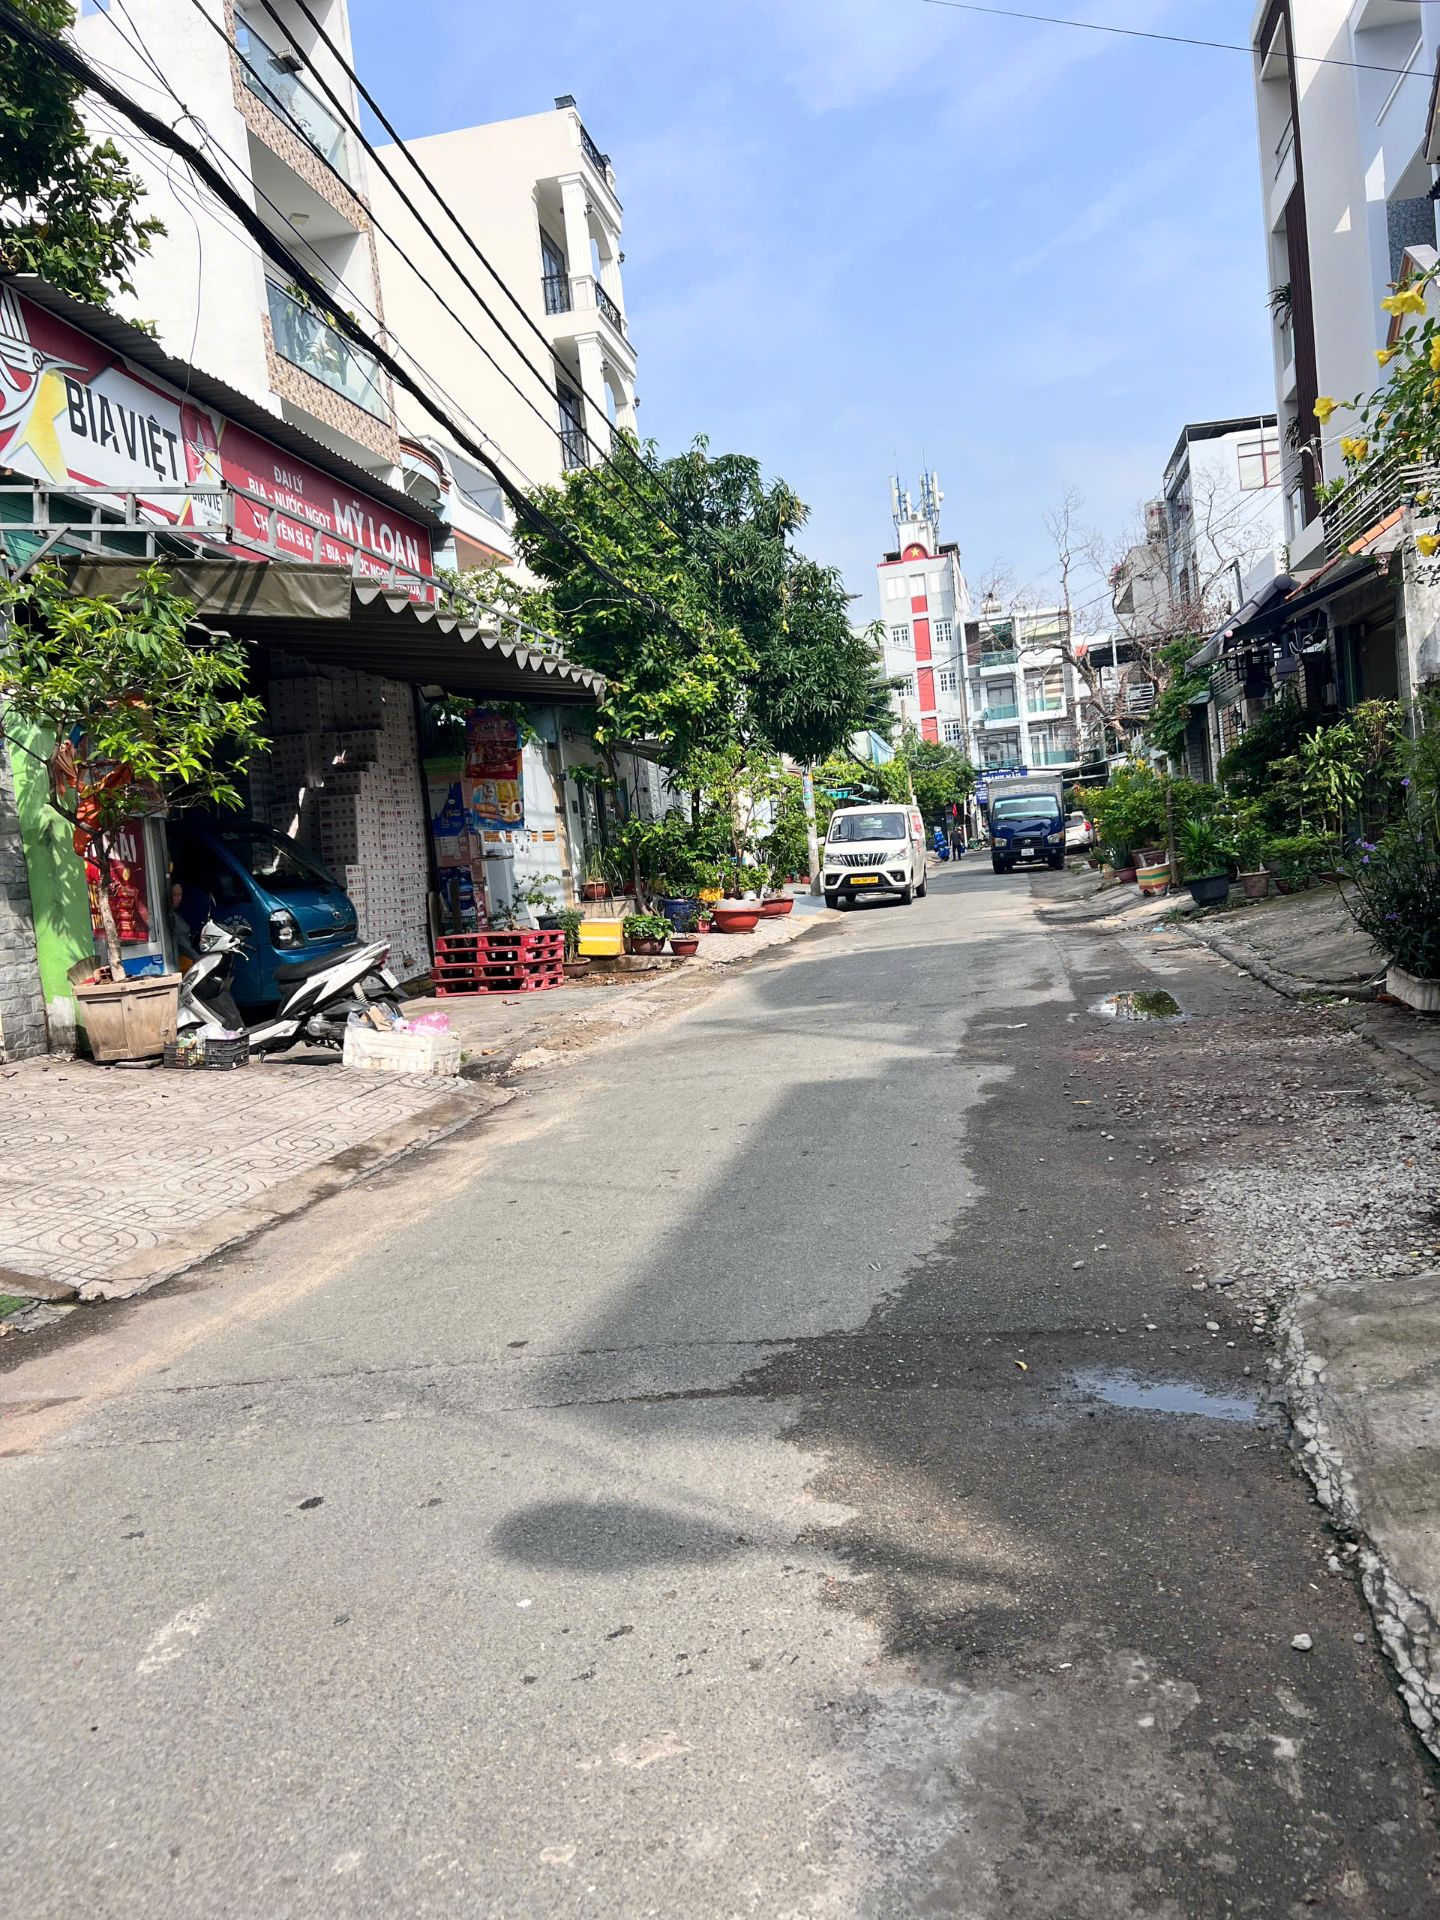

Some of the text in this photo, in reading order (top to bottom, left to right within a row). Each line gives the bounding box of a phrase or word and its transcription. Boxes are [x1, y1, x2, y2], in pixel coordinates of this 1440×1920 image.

[248, 477, 268, 499] BIA
[254, 511, 296, 544] CHYÊN
[333, 498, 364, 546] MỸ
[368, 516, 420, 573] LOAN
